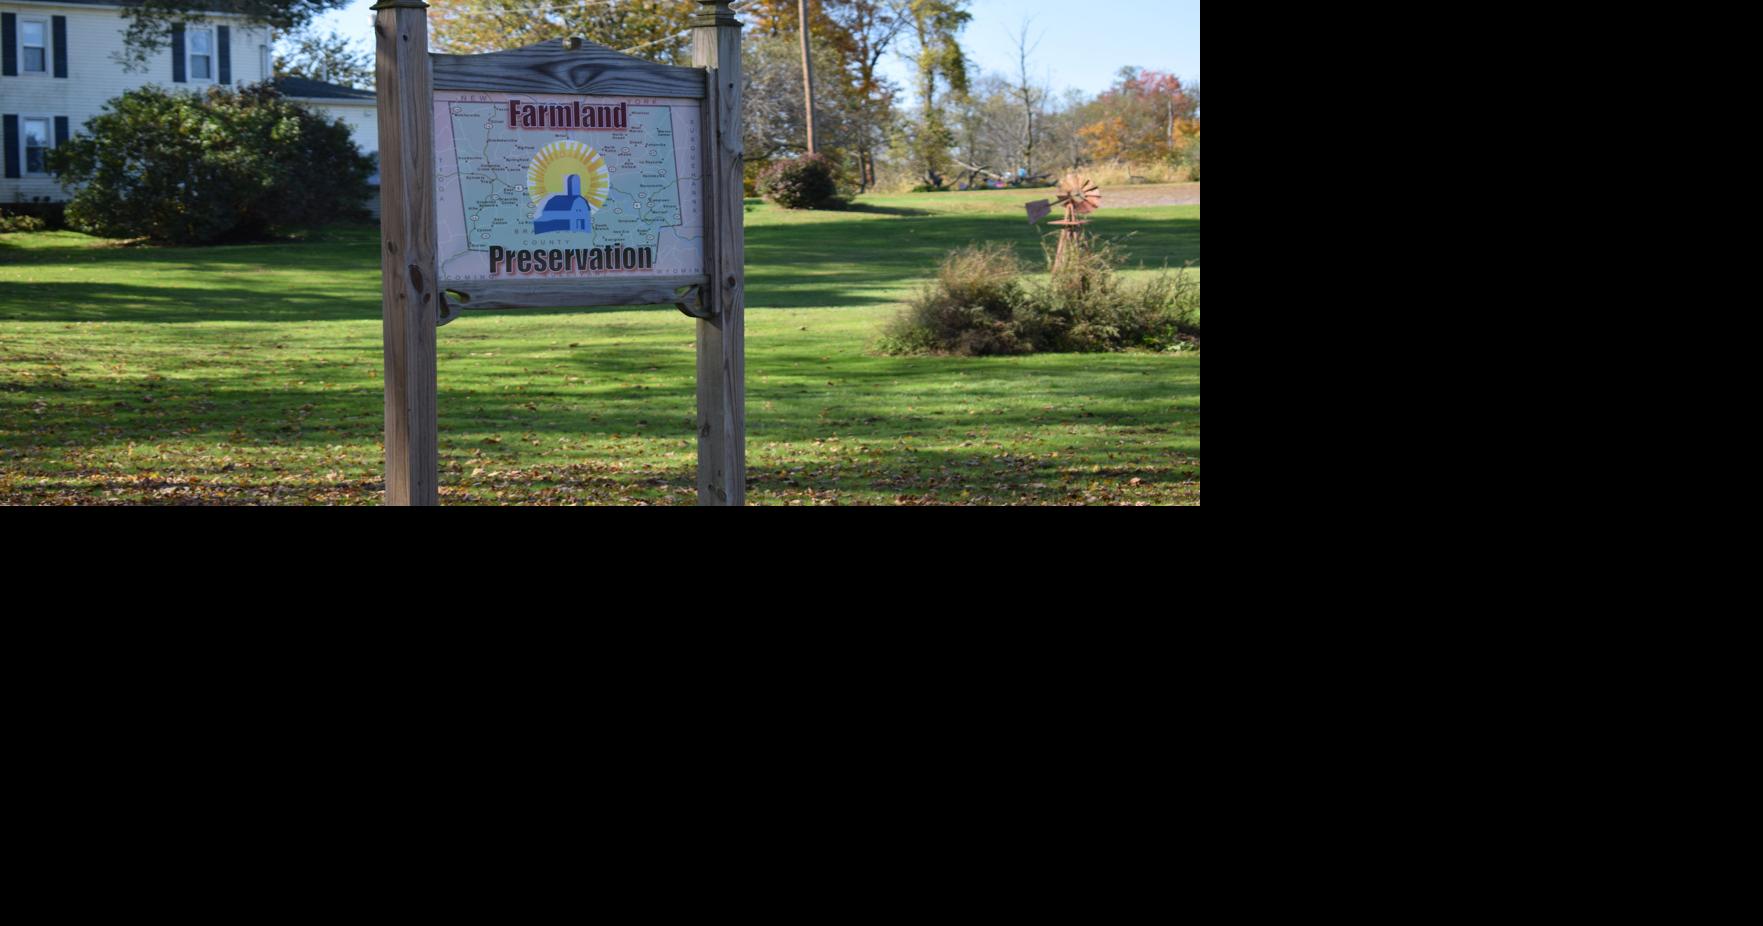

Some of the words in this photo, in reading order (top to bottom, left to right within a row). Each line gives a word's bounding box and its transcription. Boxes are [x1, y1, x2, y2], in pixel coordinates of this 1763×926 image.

[509, 99, 627, 129] Farmland
[488, 242, 652, 274] Preservation
[522, 239, 571, 247] COUNTY
